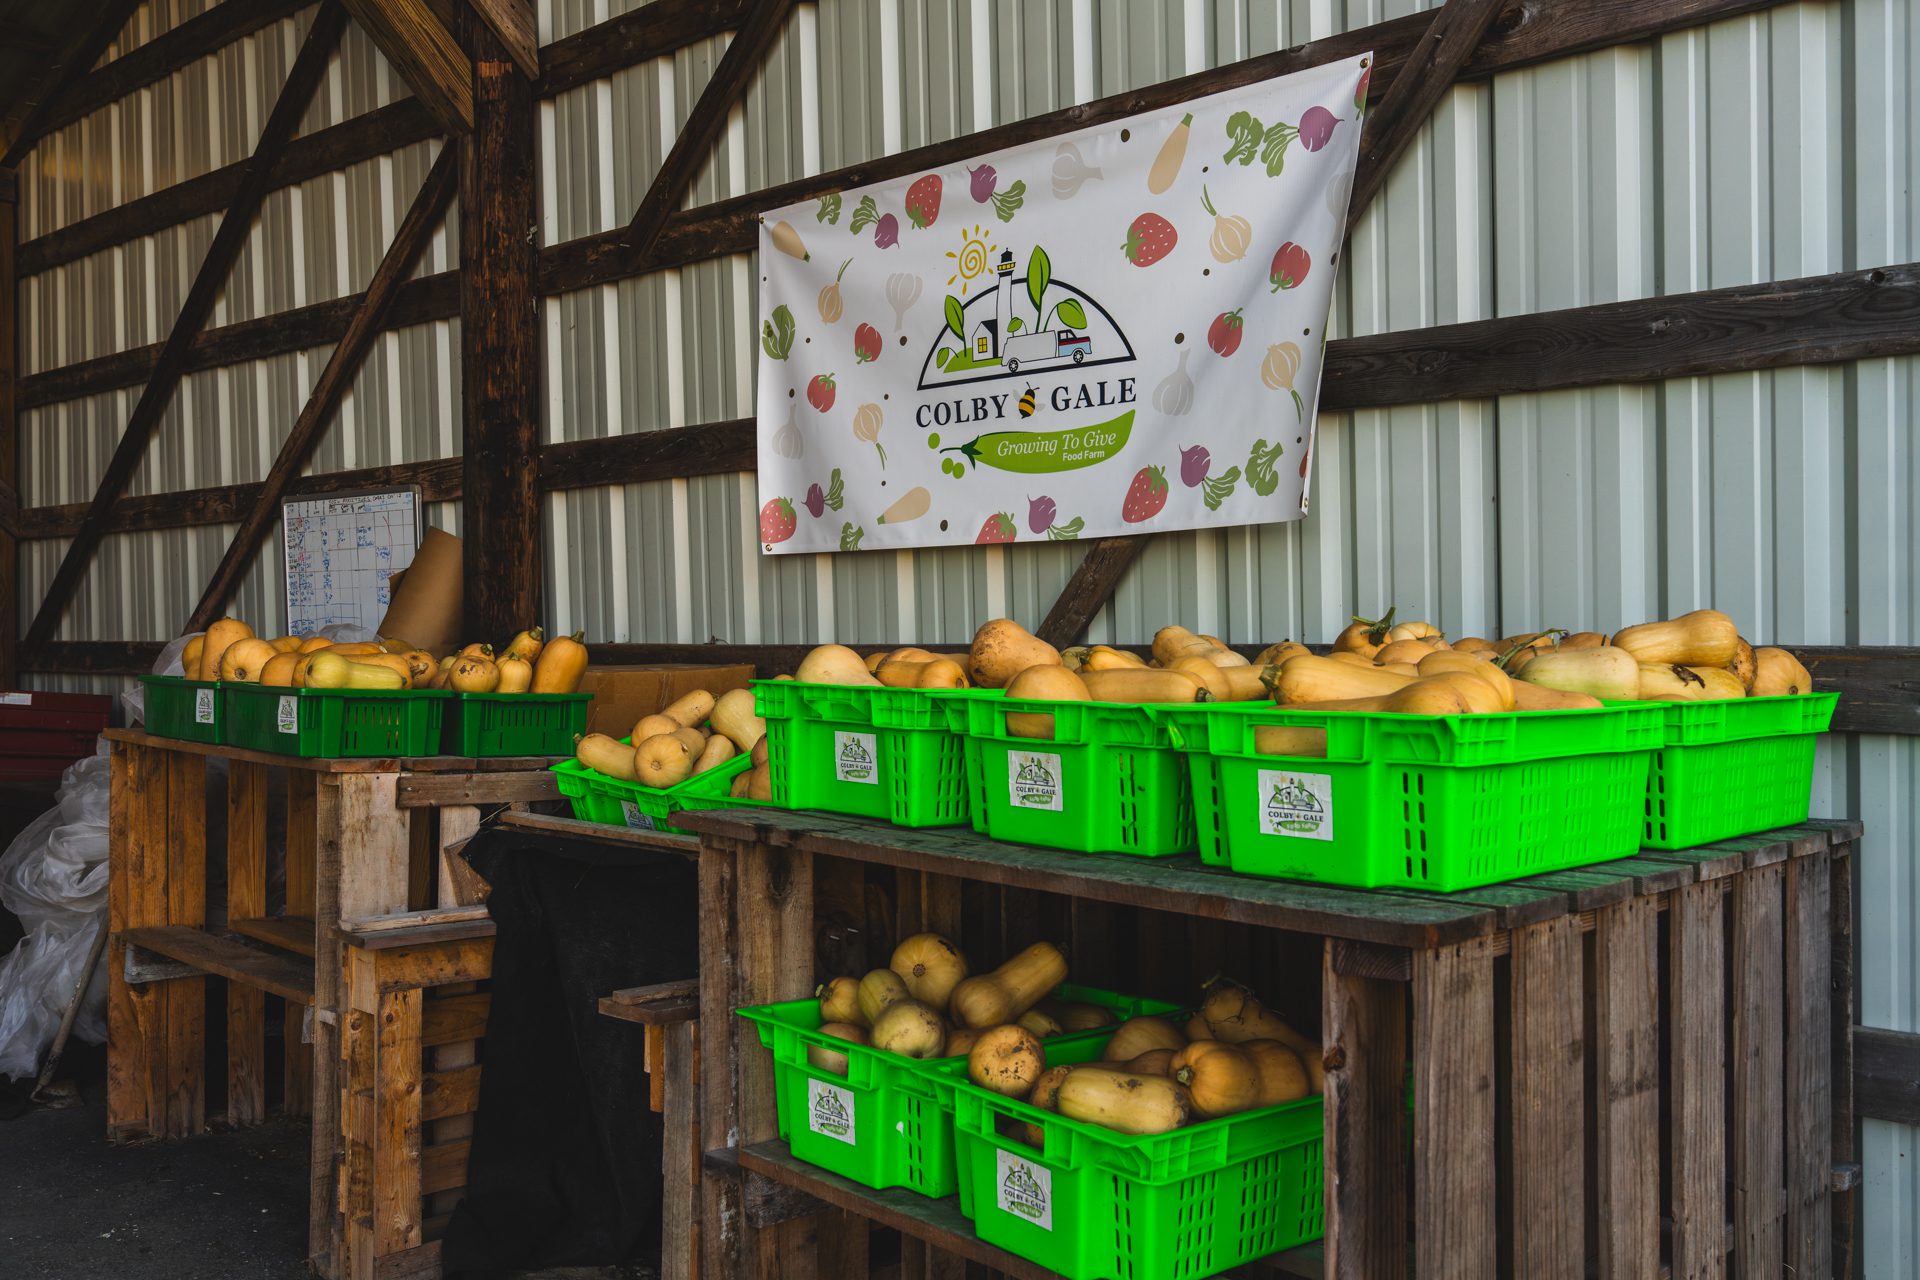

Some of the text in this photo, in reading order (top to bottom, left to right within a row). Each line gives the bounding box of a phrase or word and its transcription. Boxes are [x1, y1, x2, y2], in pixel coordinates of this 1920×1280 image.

[916, 377, 1137, 428] COLBY GALE
[997, 430, 1117, 457] Growing To Give
[1062, 449, 1105, 462] Food Farm
[1016, 785, 1035, 793] COLBY
[1268, 810, 1324, 822] COLBY GALE
[1004, 1189, 1024, 1201] COLBY
[1031, 1199, 1046, 1211] GALE
